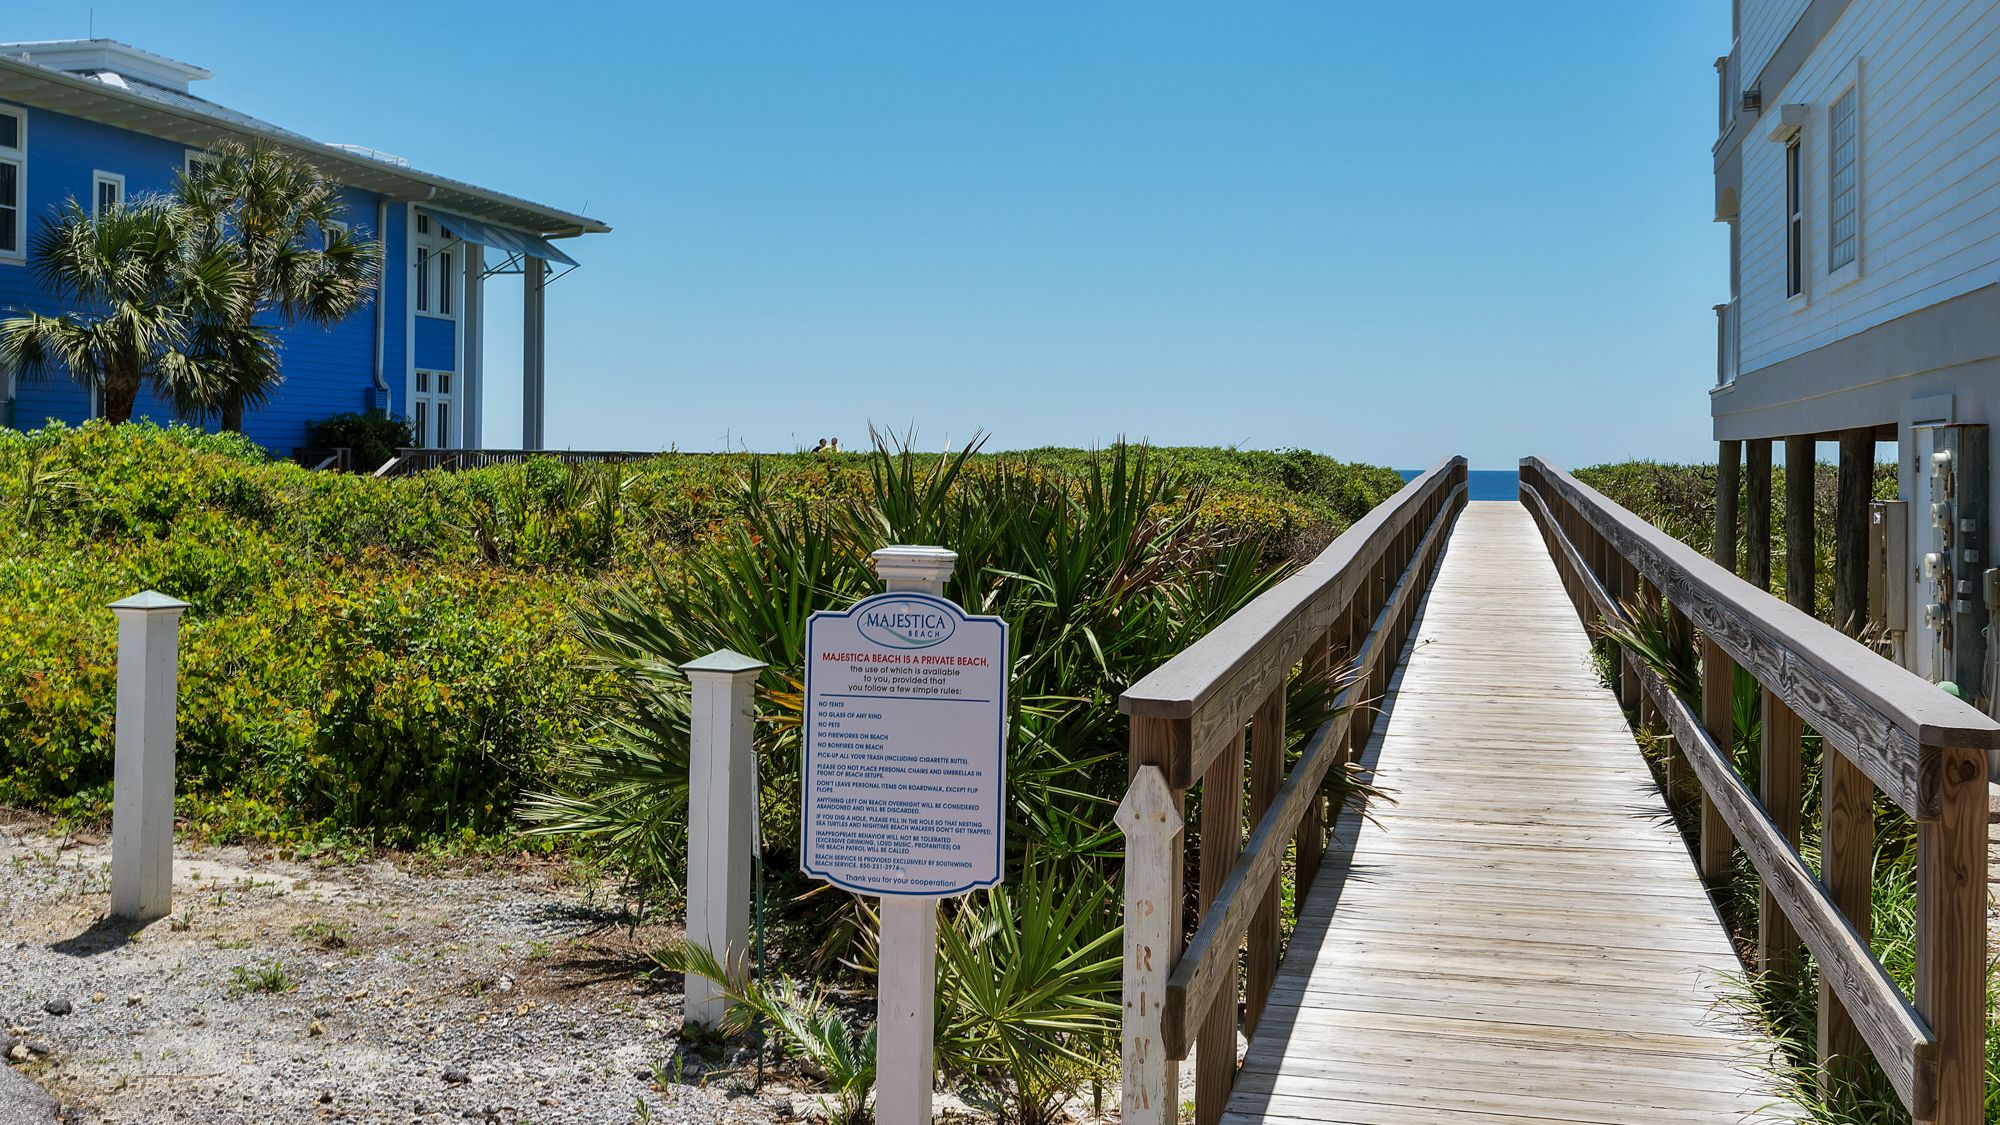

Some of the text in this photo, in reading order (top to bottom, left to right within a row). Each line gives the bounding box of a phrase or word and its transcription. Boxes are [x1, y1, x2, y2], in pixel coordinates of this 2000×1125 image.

[867, 613, 945, 629] MAJESTICA
[822, 652, 869, 662] MAJESTICA
[872, 654, 900, 663] BEACH
[922, 656, 954, 665] PRIVATE
[957, 657, 989, 667] BEACH,
[893, 676, 927, 685] provided
[912, 686, 938, 694] simple
[910, 879, 956, 887] cooperation!
